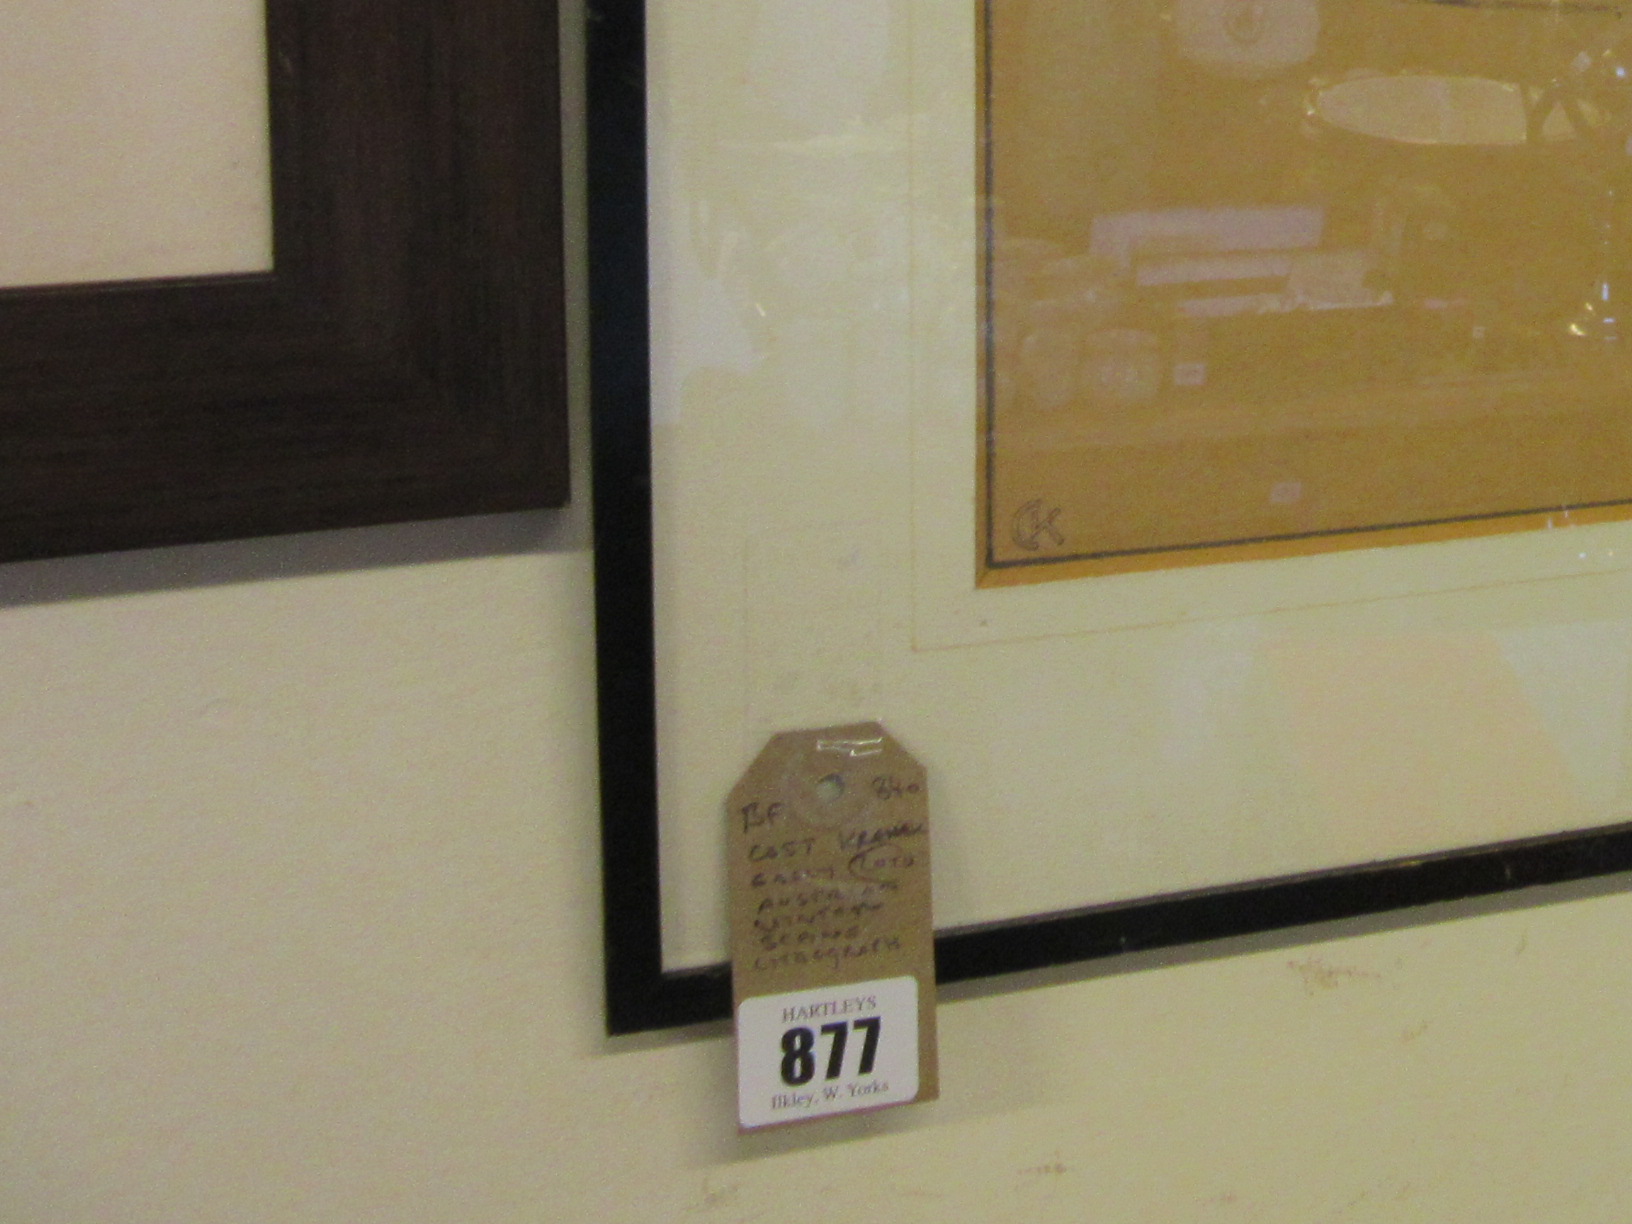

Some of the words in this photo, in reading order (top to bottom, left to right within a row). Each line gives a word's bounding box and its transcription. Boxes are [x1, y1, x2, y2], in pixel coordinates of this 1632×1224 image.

[782, 996, 876, 1023] HARTLEYS
[780, 1016, 881, 1085] 877
[822, 1085, 843, 1101] W.
[848, 1079, 890, 1098] Yorks
